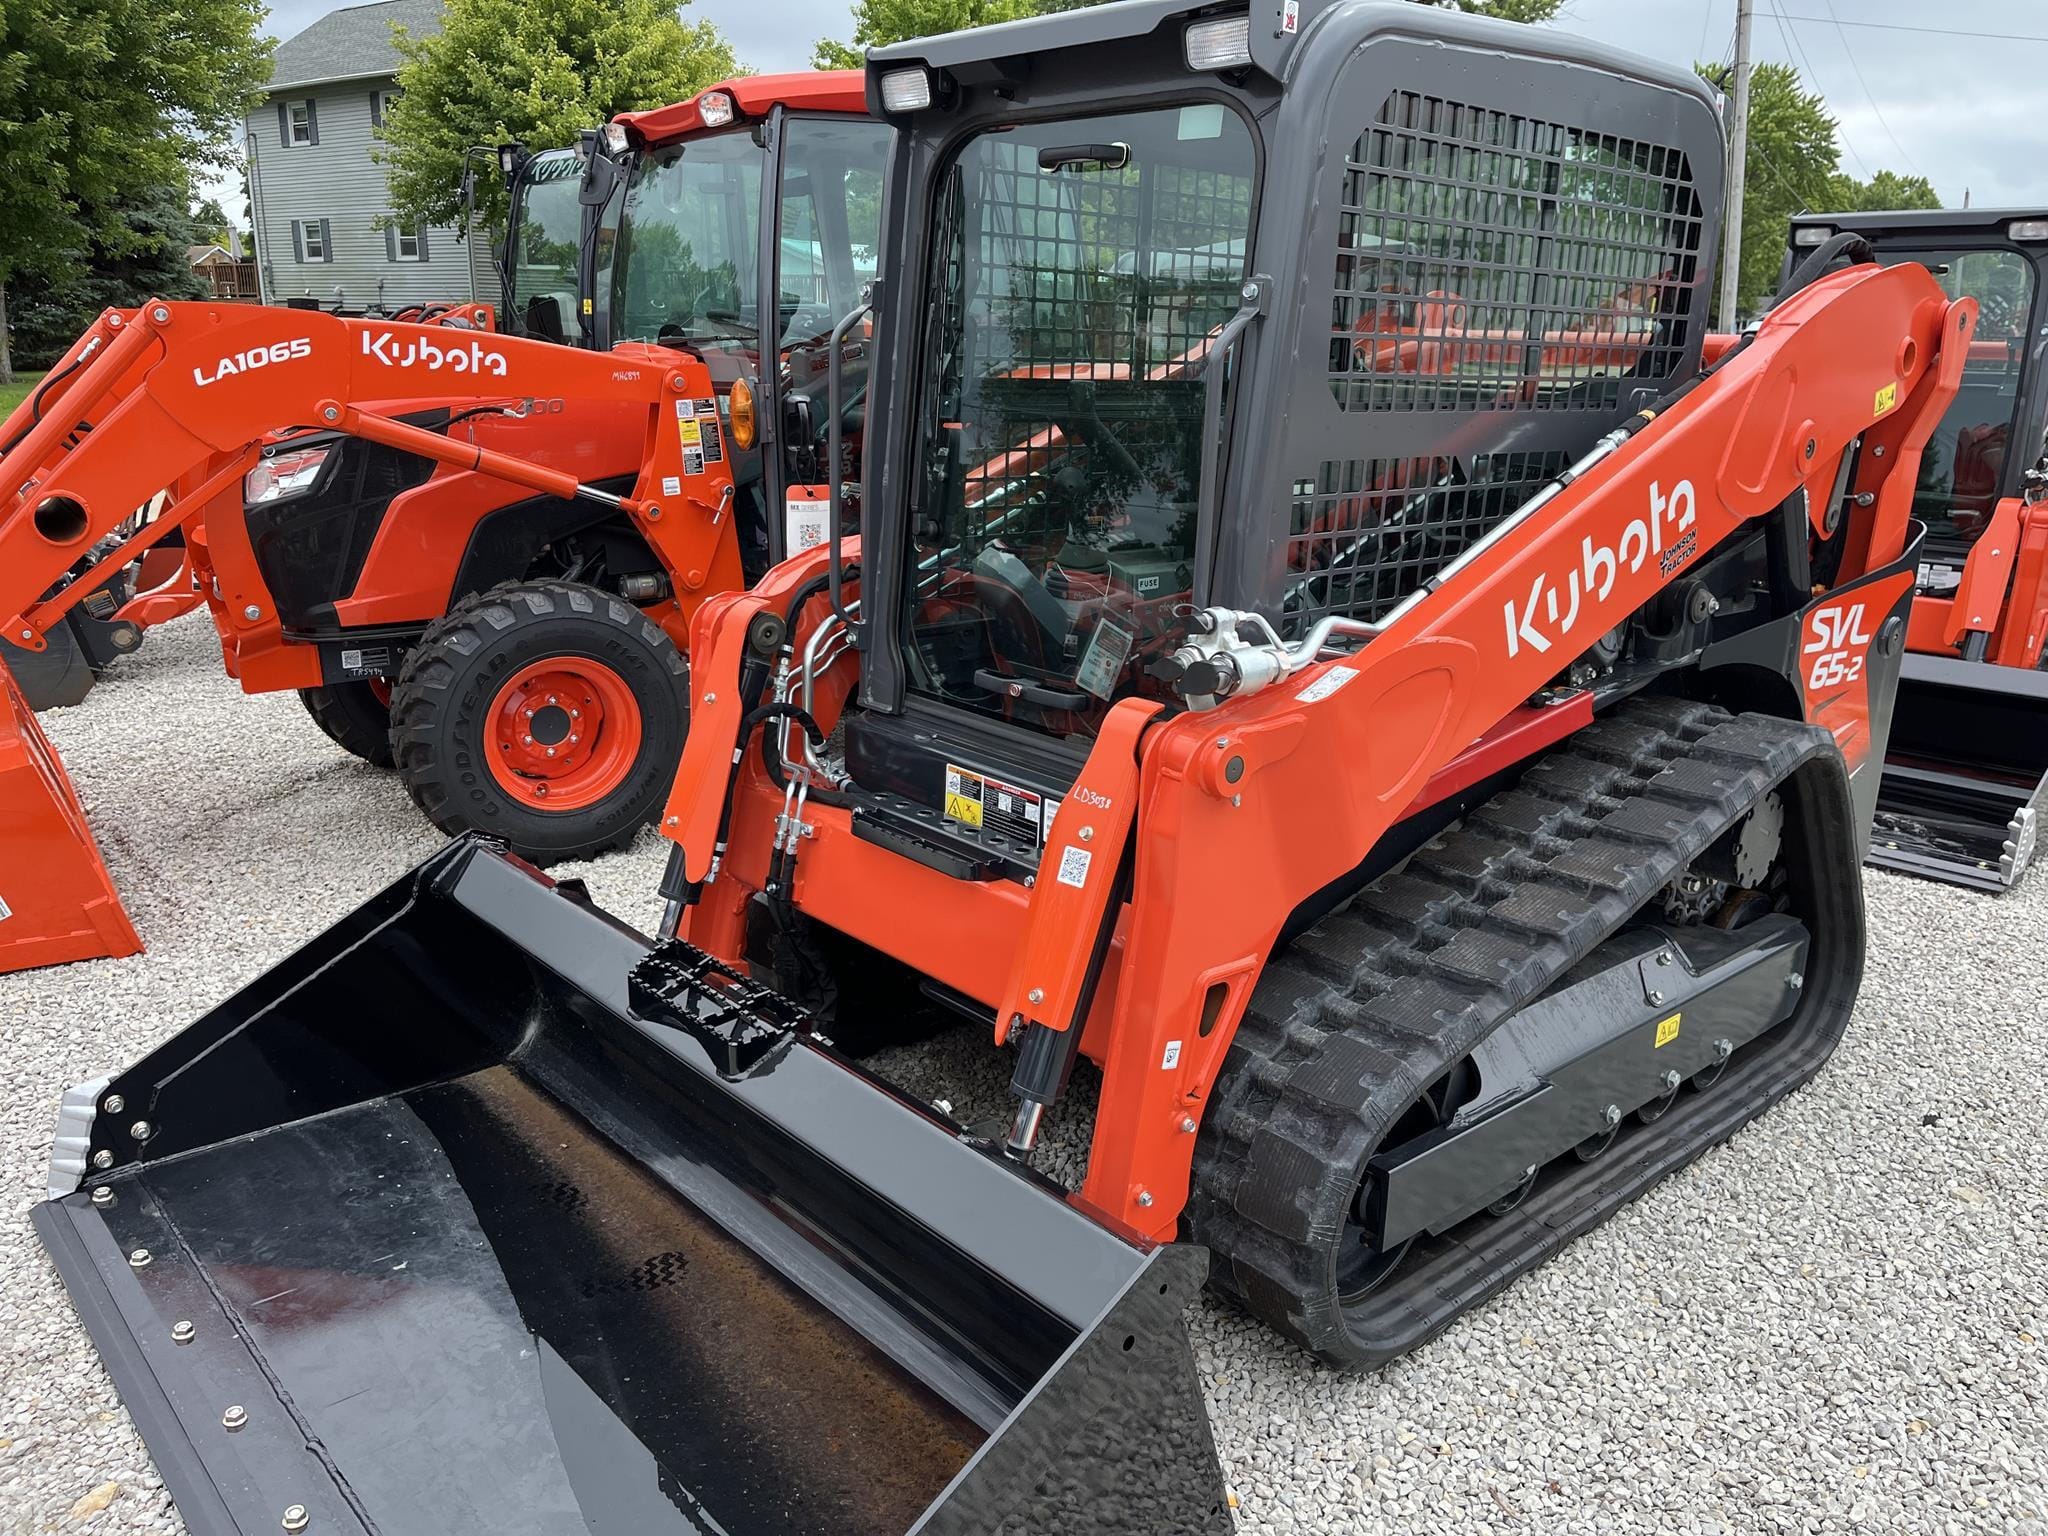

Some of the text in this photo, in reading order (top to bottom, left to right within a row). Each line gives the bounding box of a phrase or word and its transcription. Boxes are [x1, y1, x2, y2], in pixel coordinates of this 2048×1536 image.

[193, 337, 311, 386] LA1065
[362, 330, 507, 376] Kubota
[1660, 528, 1697, 566] JOHNSON
[1661, 542, 1697, 578] TRACTOR
[1139, 578, 1159, 589] FUSE
[1504, 480, 1695, 659] Kubota
[1803, 604, 1870, 654] SVL
[1809, 651, 1863, 690] 65-2
[1073, 784, 1112, 809] LD3038
